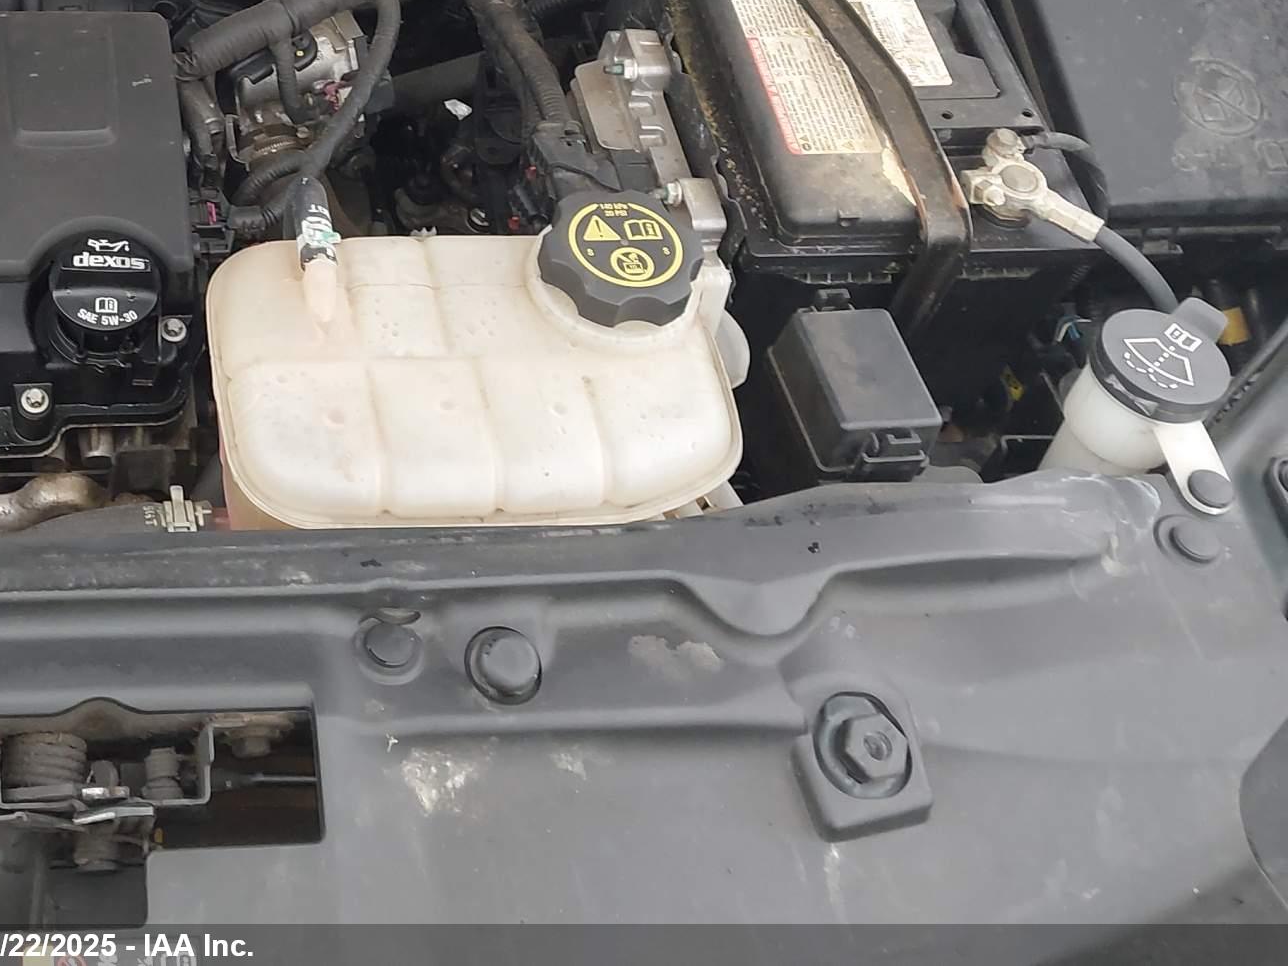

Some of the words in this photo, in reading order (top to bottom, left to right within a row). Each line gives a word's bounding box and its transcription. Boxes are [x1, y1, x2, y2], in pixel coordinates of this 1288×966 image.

[72, 251, 147, 270] dexos
[77, 308, 98, 324] SAE
[101, 310, 138, 325] 5W-30
